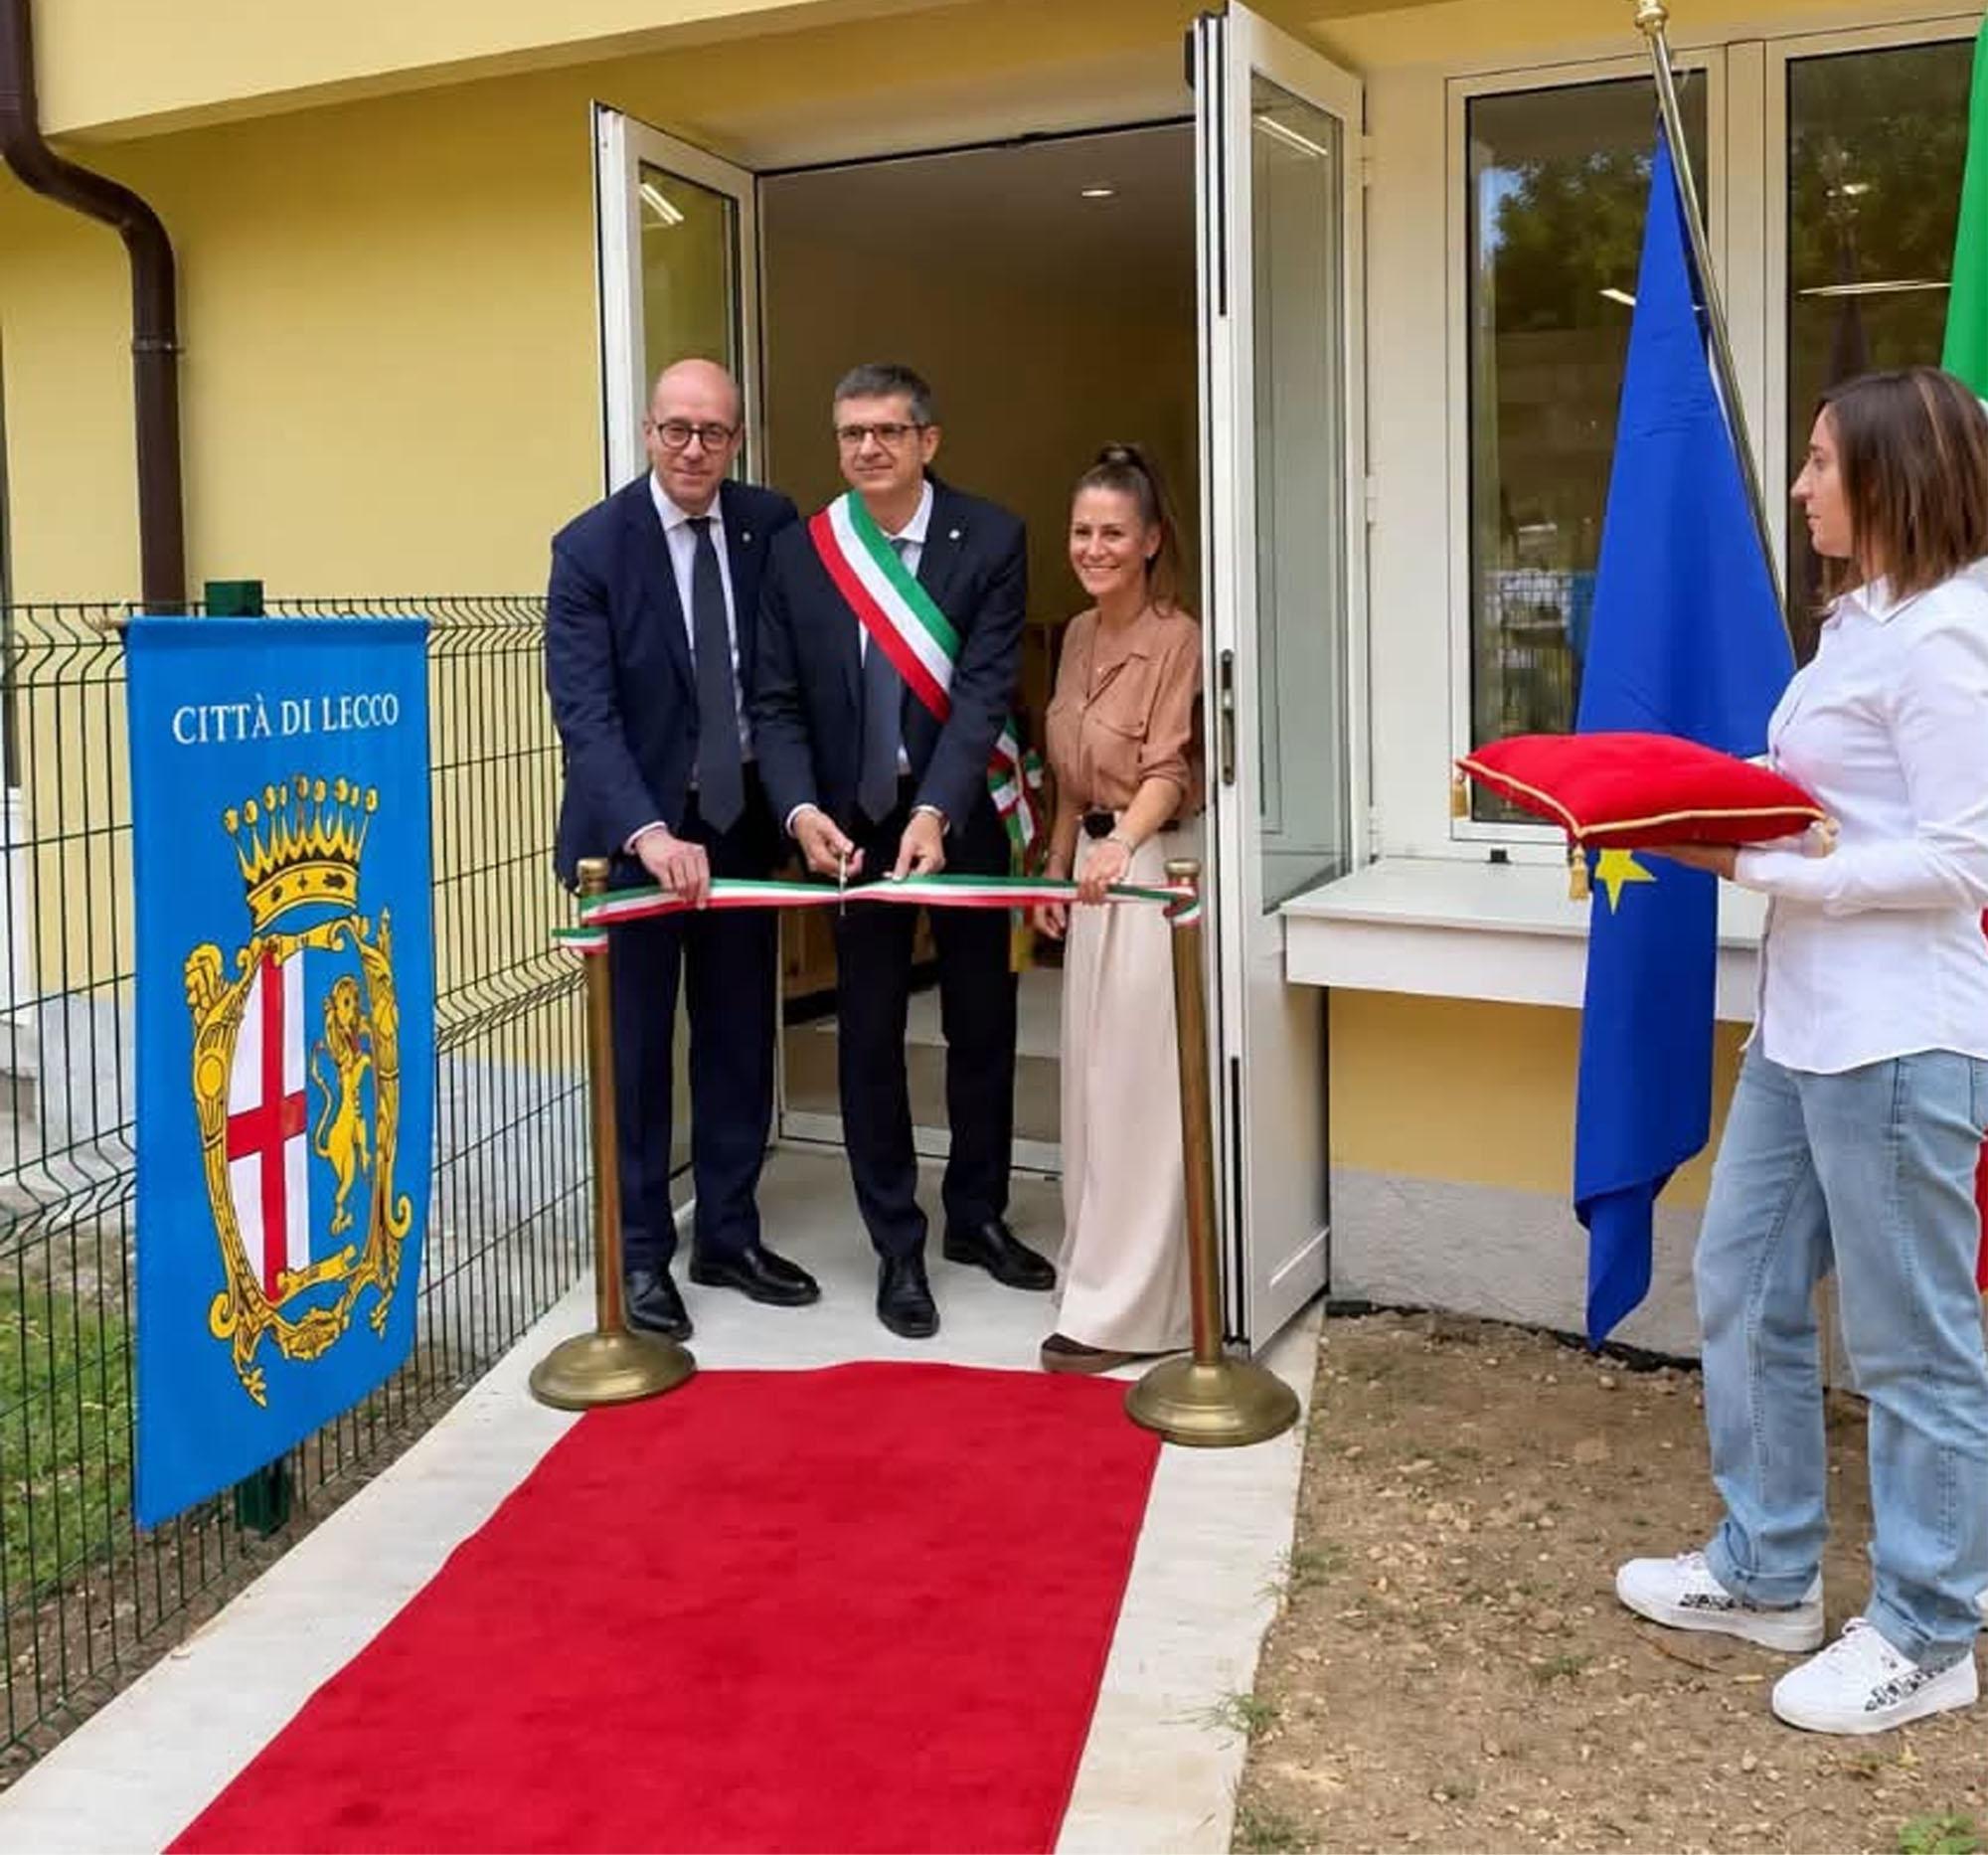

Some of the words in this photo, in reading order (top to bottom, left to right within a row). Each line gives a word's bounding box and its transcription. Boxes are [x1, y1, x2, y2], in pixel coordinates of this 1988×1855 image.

[172, 694, 271, 745] CITTÀ
[280, 699, 312, 736] DI
[322, 693, 399, 732] LECCO
